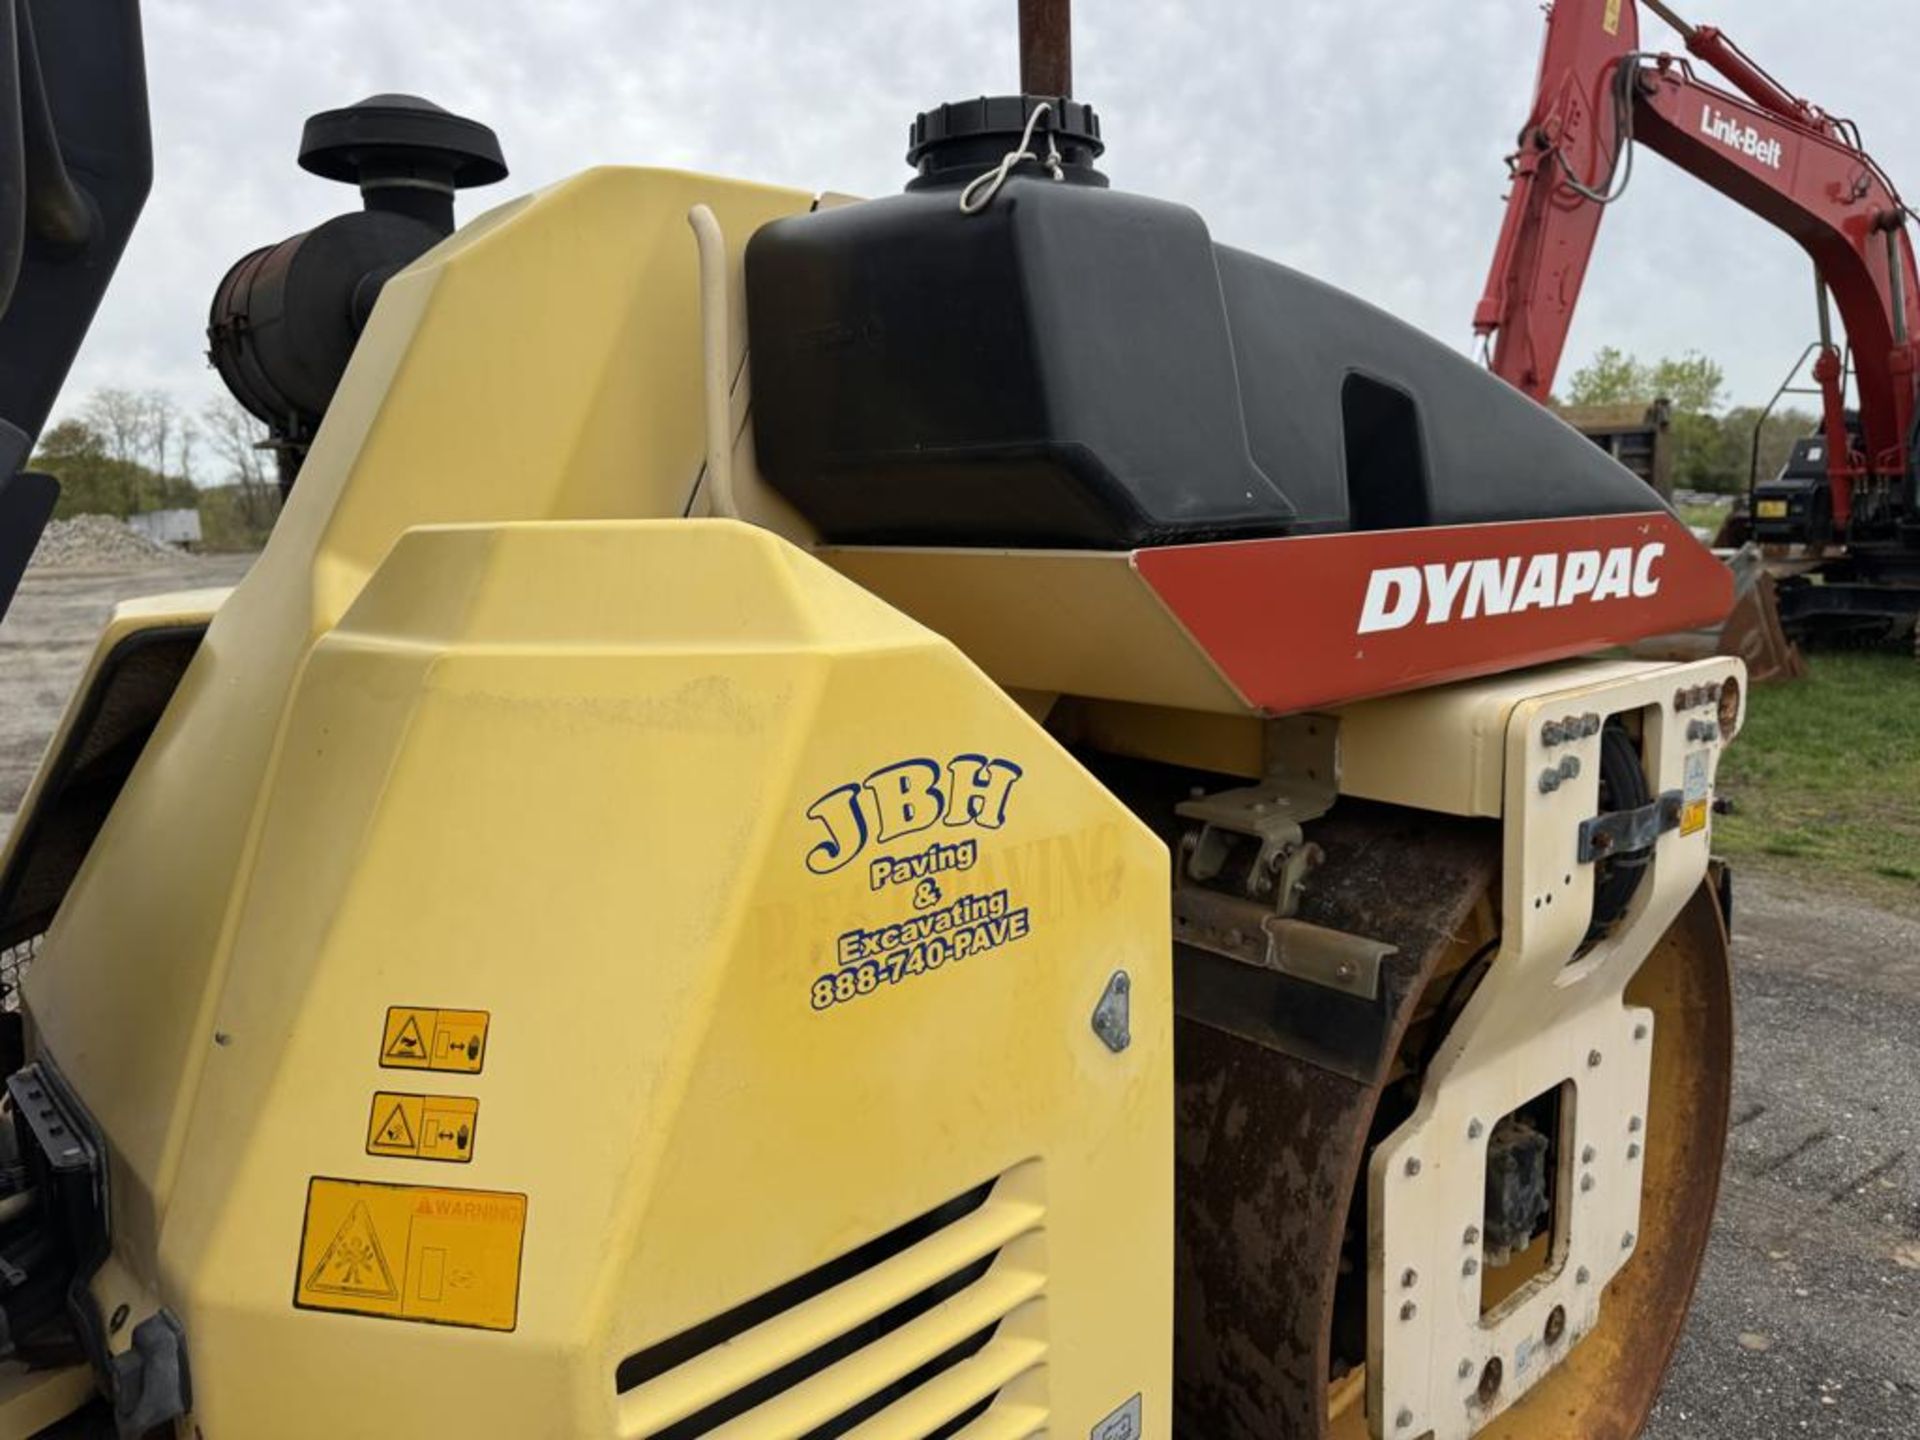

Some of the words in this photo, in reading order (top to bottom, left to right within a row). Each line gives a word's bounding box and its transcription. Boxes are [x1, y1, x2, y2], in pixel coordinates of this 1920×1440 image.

[1701, 105, 1783, 170] Link-Belt
[1357, 542, 1665, 634] DYNAPAC
[805, 754, 1023, 874] JBH
[869, 839, 978, 890] Paving
[912, 877, 942, 909] &
[810, 908, 1030, 1011] 888-740-PAVE
[837, 889, 1008, 965] Excavating
[435, 1199, 520, 1224] WARNING
